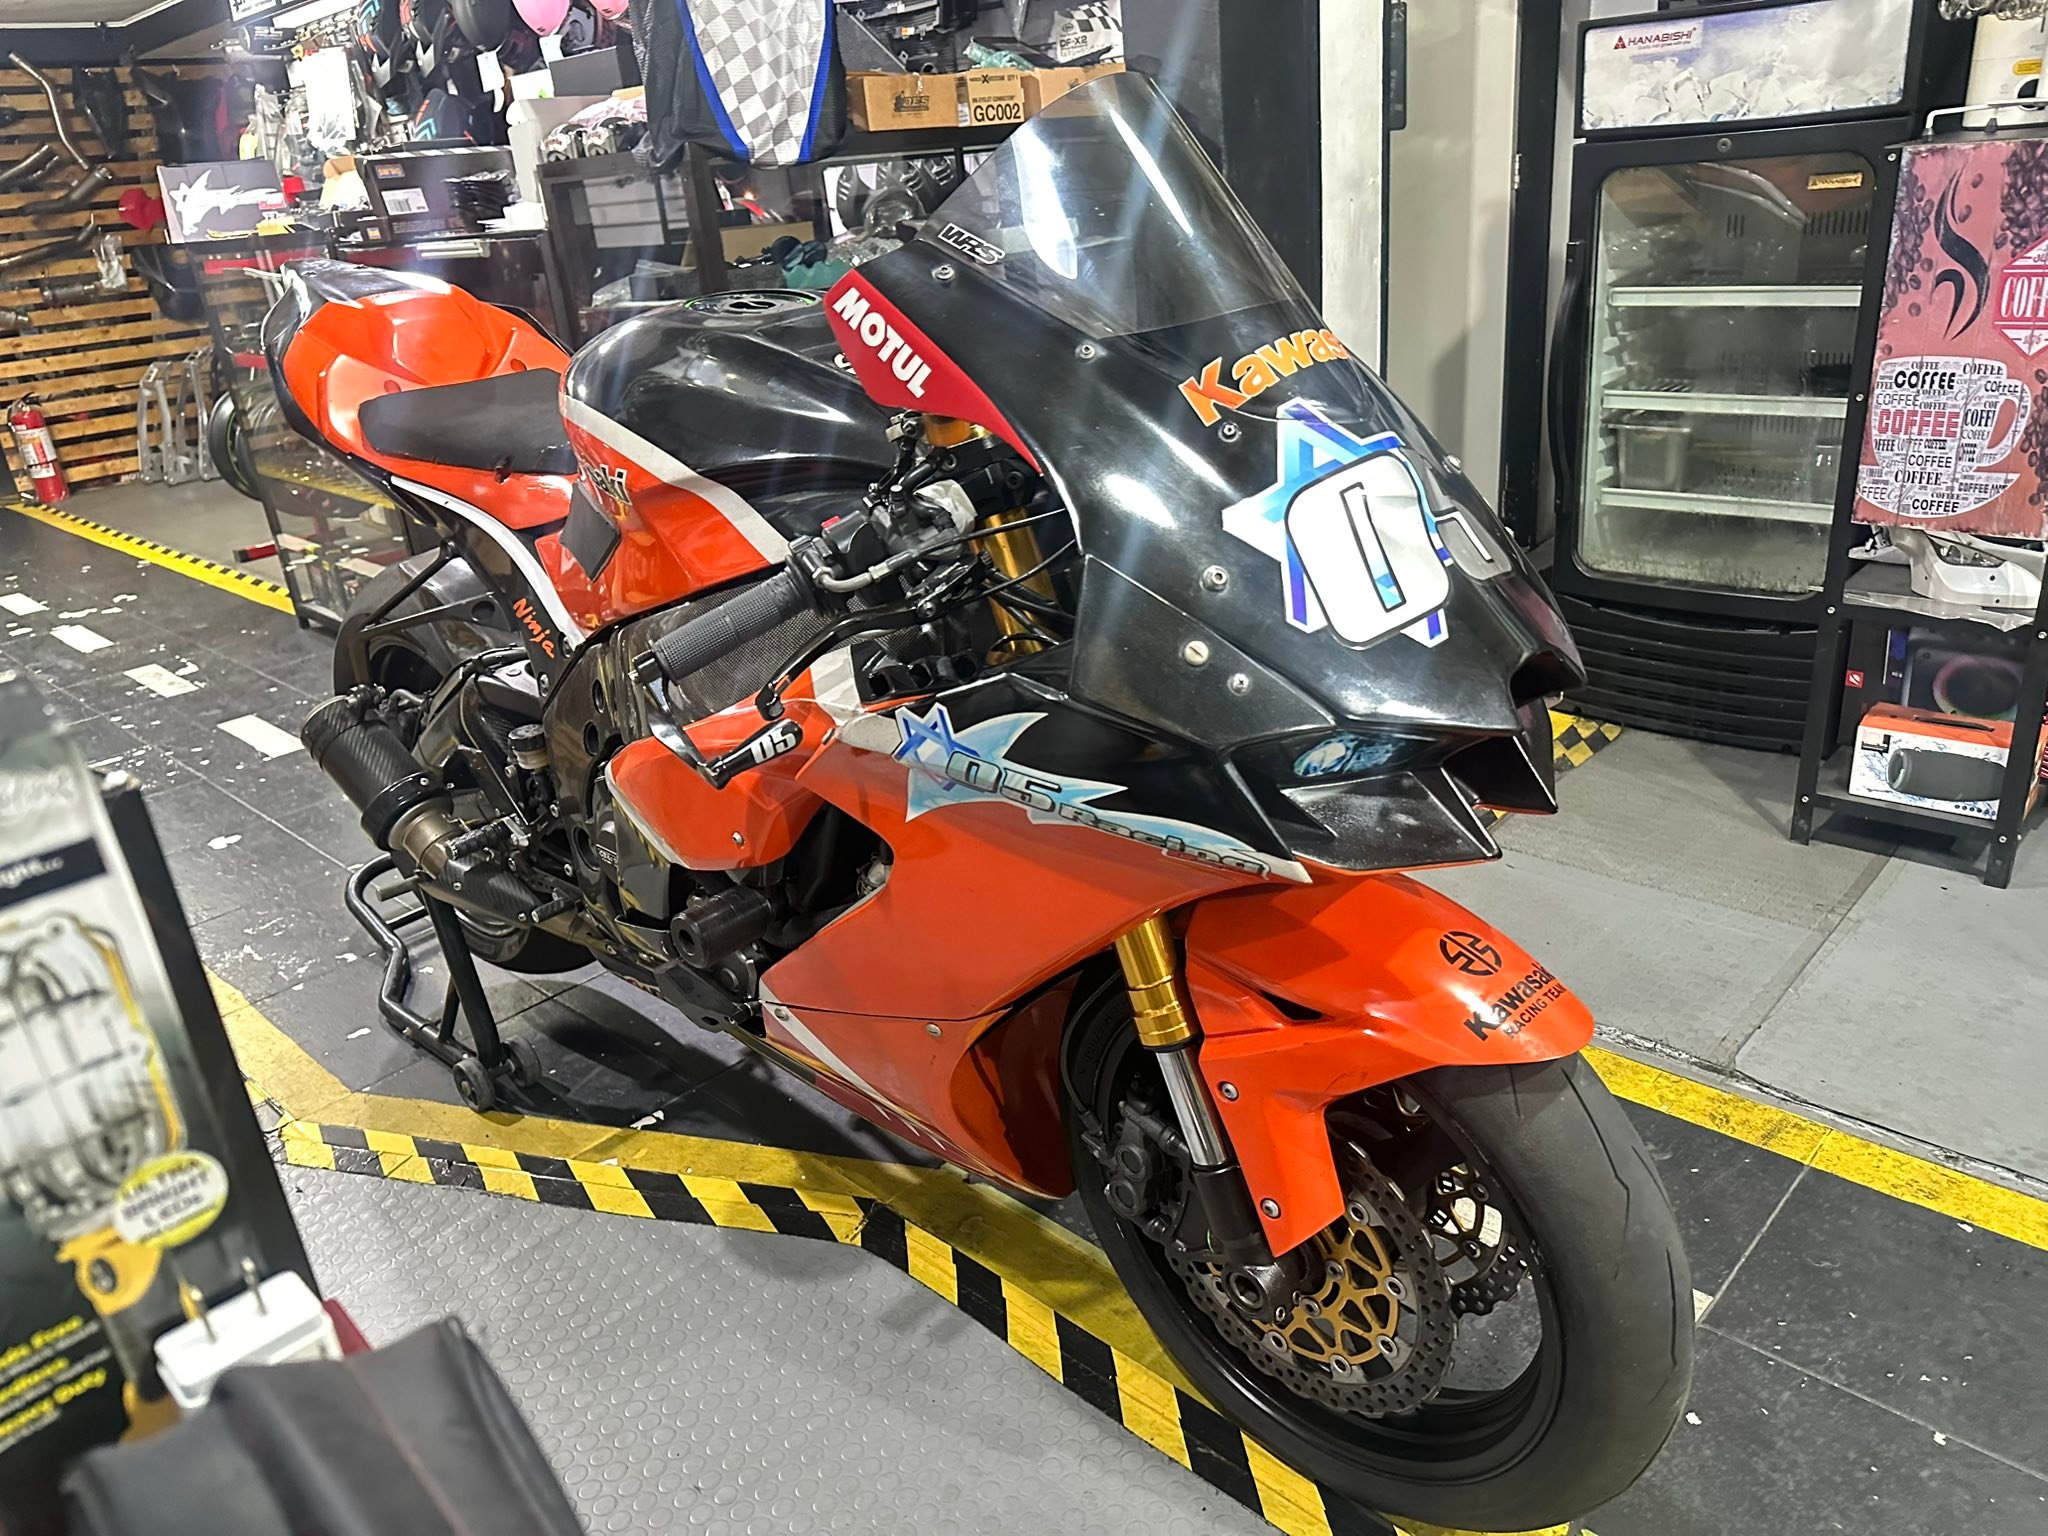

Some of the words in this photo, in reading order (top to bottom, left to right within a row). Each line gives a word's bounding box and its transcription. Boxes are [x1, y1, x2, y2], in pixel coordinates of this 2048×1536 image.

[1060, 35, 1088, 48] DF-X2
[1627, 31, 1693, 46] HANABISHI
[974, 102, 1022, 122] GC002
[939, 224, 1005, 264] WRS
[832, 287, 932, 398] MOTUL
[1963, 363, 2003, 375] COFFEE
[1877, 409, 1961, 438] COFFEE
[1908, 454, 1953, 468] COFFEE
[1895, 469, 1943, 486] COFFEE
[1912, 498, 1960, 513] COFFEE
[513, 598, 555, 658] Ninja
[750, 727, 796, 764] 05
[945, 750, 1062, 812] 05
[1503, 998, 1548, 1040] RACING
